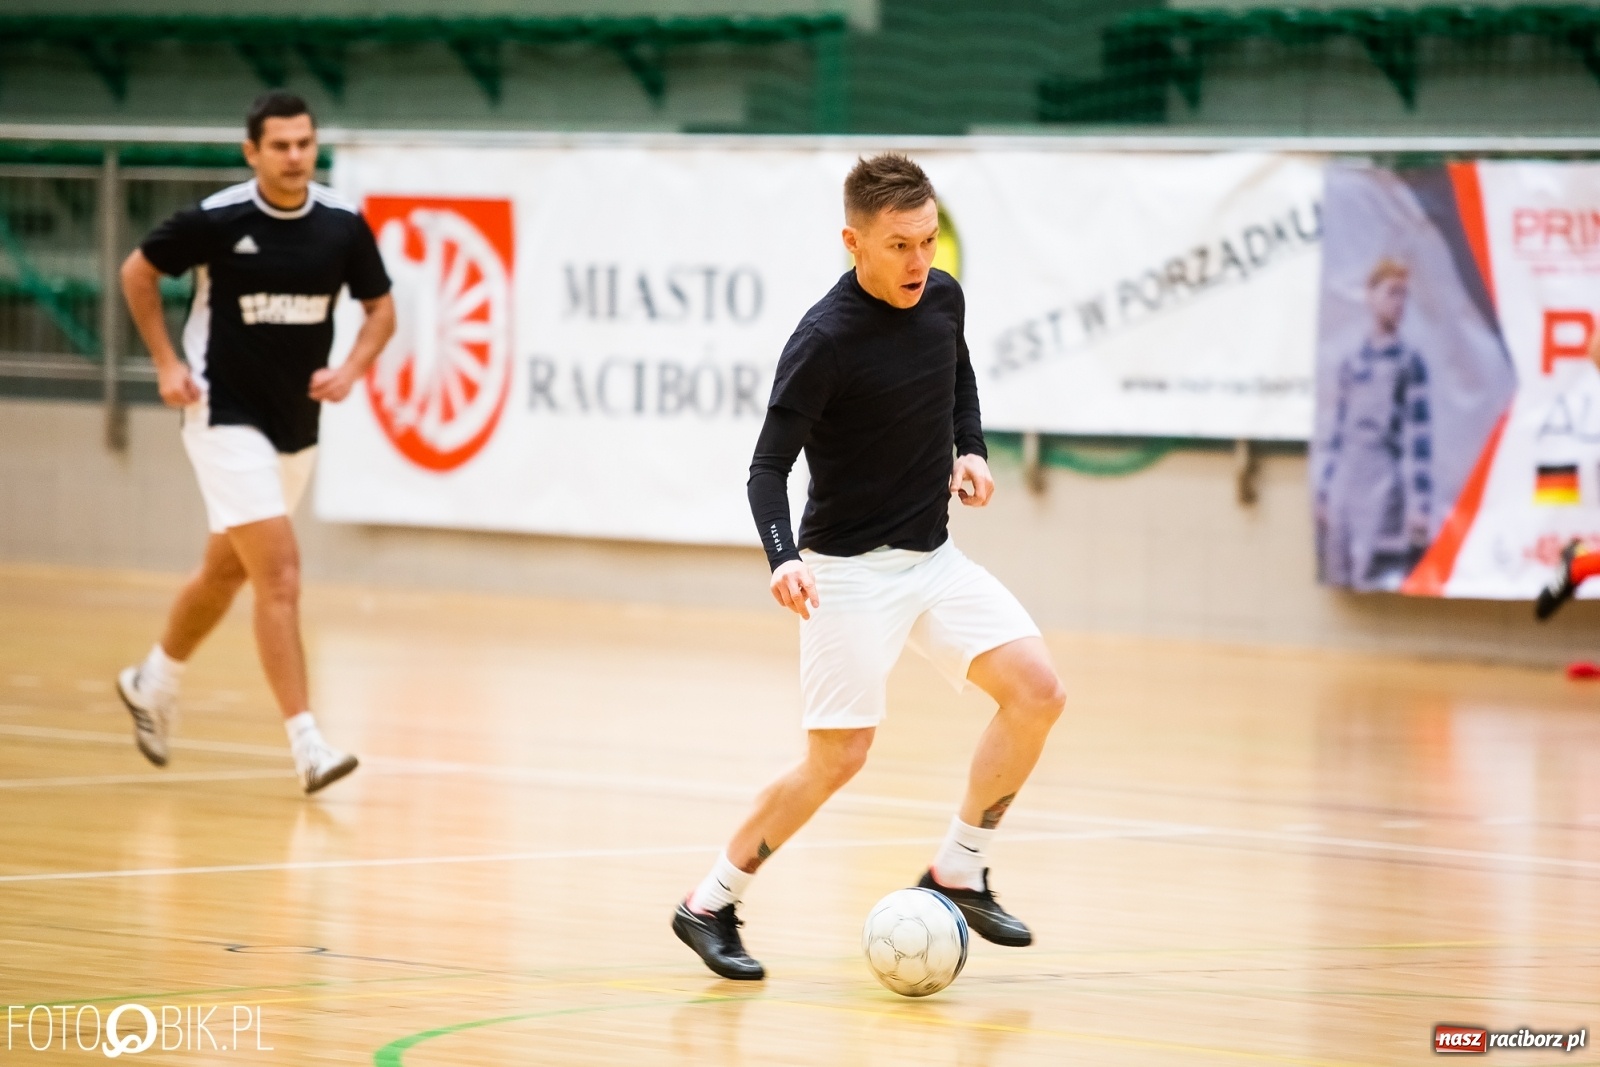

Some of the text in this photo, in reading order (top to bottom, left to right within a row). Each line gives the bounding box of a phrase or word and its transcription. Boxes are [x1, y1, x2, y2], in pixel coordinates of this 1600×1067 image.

[562, 264, 764, 326] MIASTO
[1073, 295, 1109, 341] W
[526, 343, 772, 418] RACIBÓR
[770, 523, 783, 553] KIPSTA
